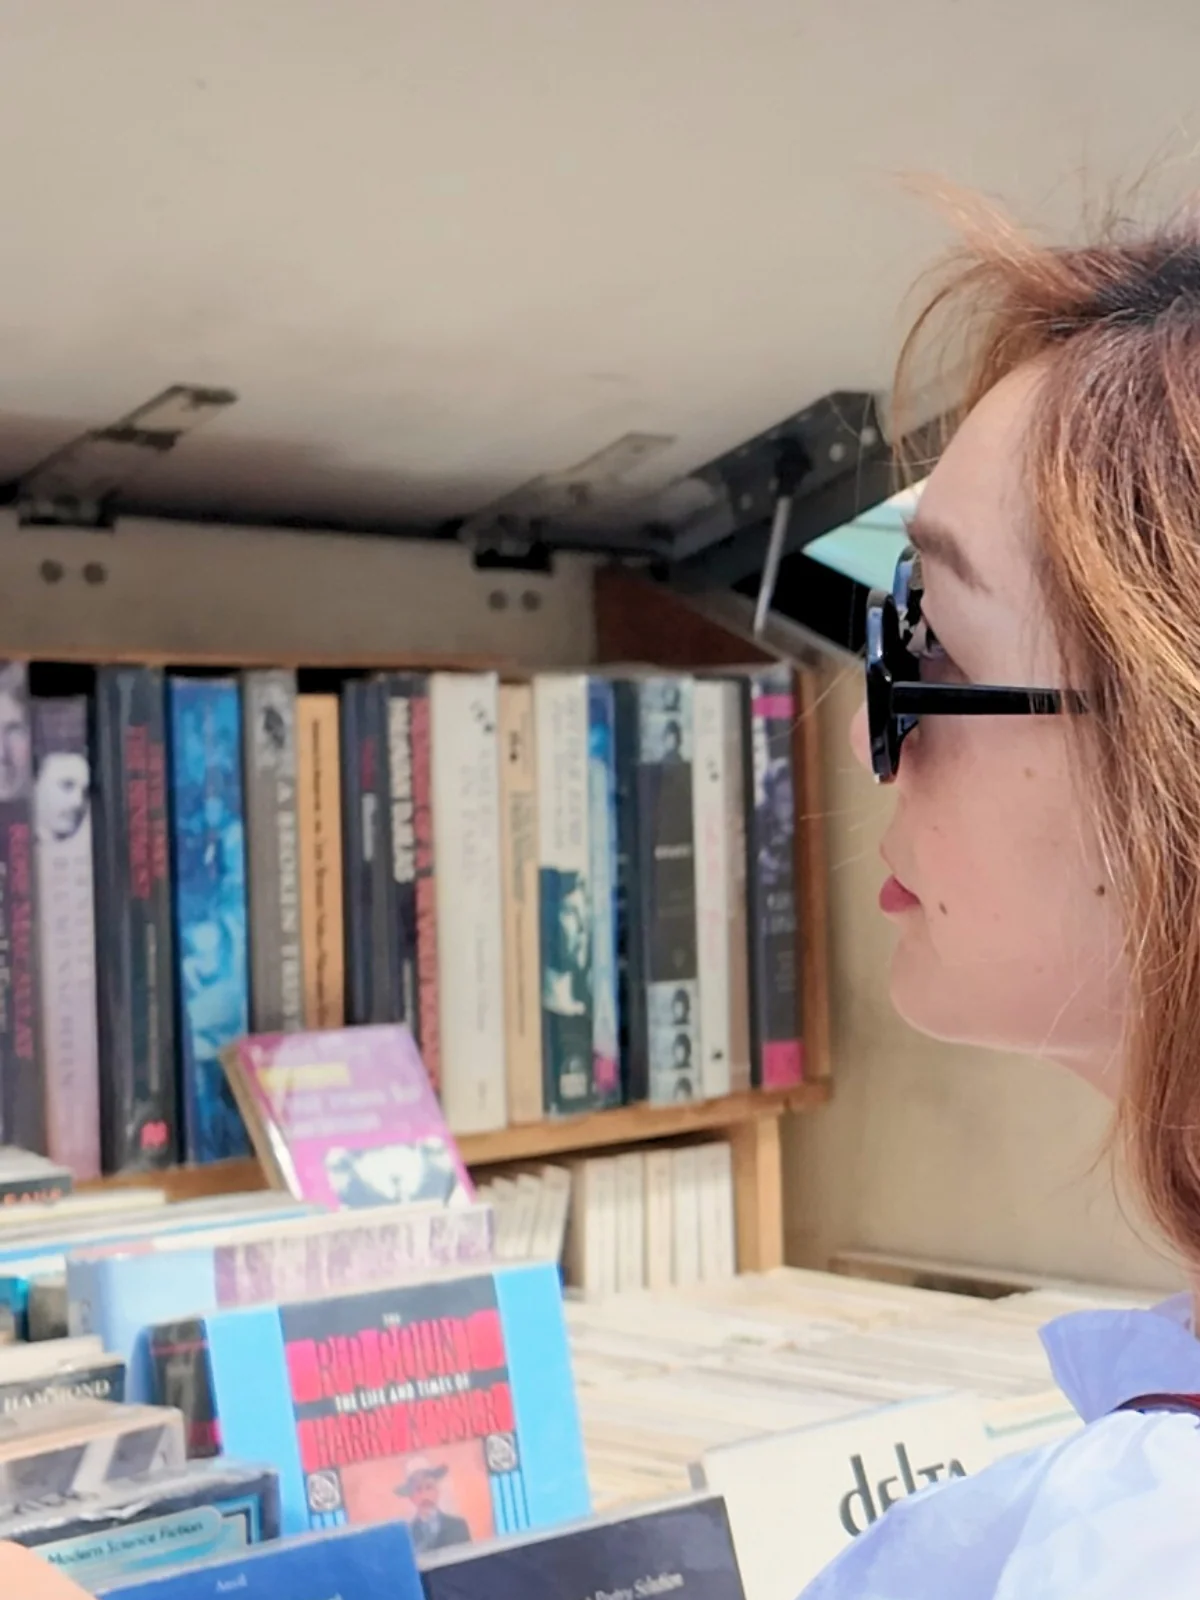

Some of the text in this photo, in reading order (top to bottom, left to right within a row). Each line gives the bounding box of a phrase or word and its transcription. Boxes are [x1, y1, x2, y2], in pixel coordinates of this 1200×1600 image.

[335, 1370, 469, 1414] THE LIFE AND TIMES OF
[315, 1406, 394, 1465] HARRY
[47, 1546, 103, 1567] Modern
